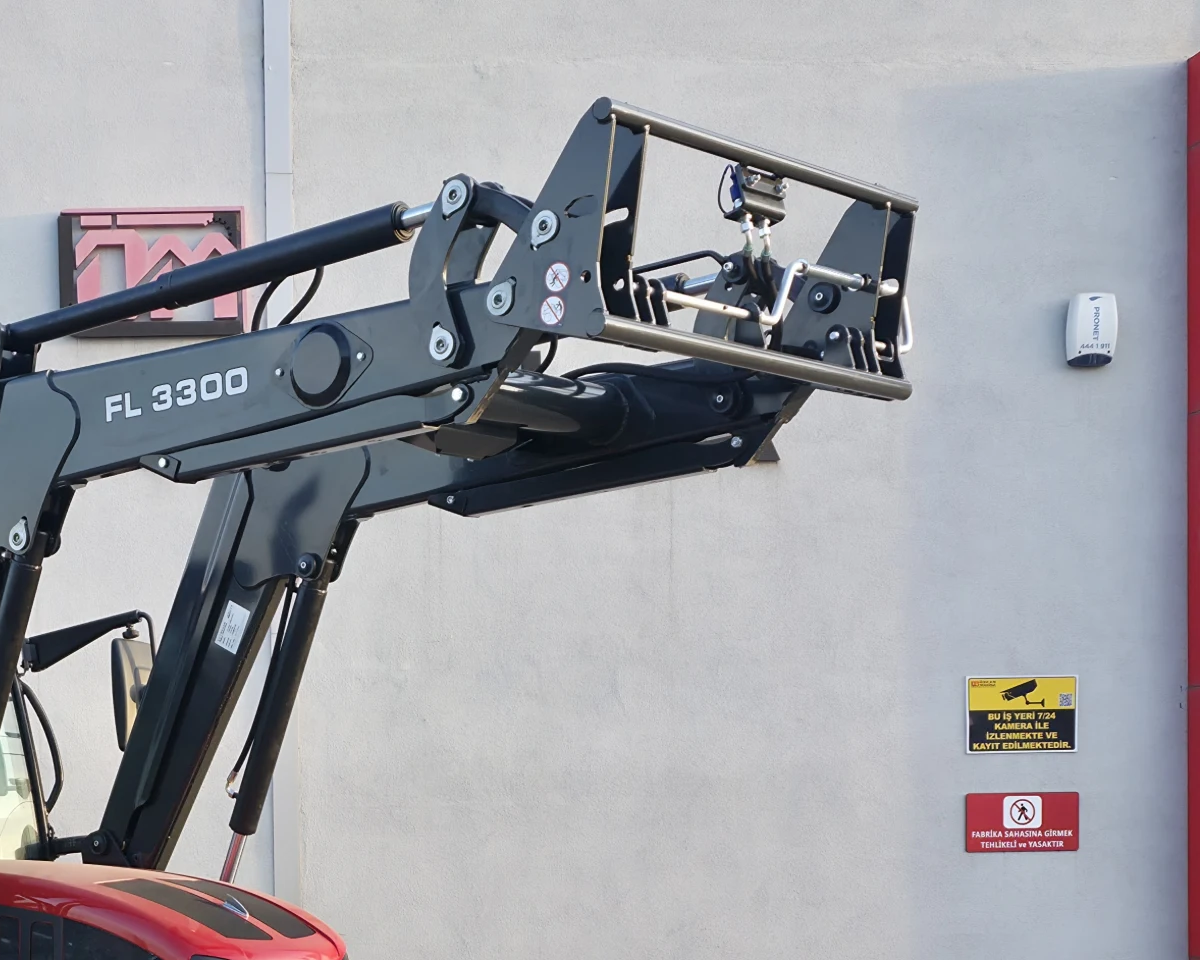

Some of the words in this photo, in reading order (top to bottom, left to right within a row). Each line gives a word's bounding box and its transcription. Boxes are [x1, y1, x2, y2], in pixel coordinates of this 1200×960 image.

[1092, 306, 1101, 341] PRONET
[104, 391, 142, 423] FL
[151, 366, 248, 413] 3300
[987, 712, 1001, 720] BU
[1003, 711, 1012, 721] İŞ
[1014, 711, 1036, 720] YERİ
[1037, 712, 1056, 720] 7/24
[994, 722, 1033, 730] KAMERA
[1035, 720, 1049, 729] İLE
[986, 731, 1043, 740] İZLENMEKTE
[1045, 731, 1058, 739] VE
[972, 742, 1000, 750] KAYIT
[1002, 740, 1072, 749] EDİLMEKTEDİR.
[971, 829, 1003, 838] FABRİKA
[1004, 830, 1043, 838] SAHASINA
[1044, 829, 1073, 837] GİRMEK
[980, 840, 1017, 848] TEHLİKELİ
[1028, 840, 1064, 848] YASAKTIR
